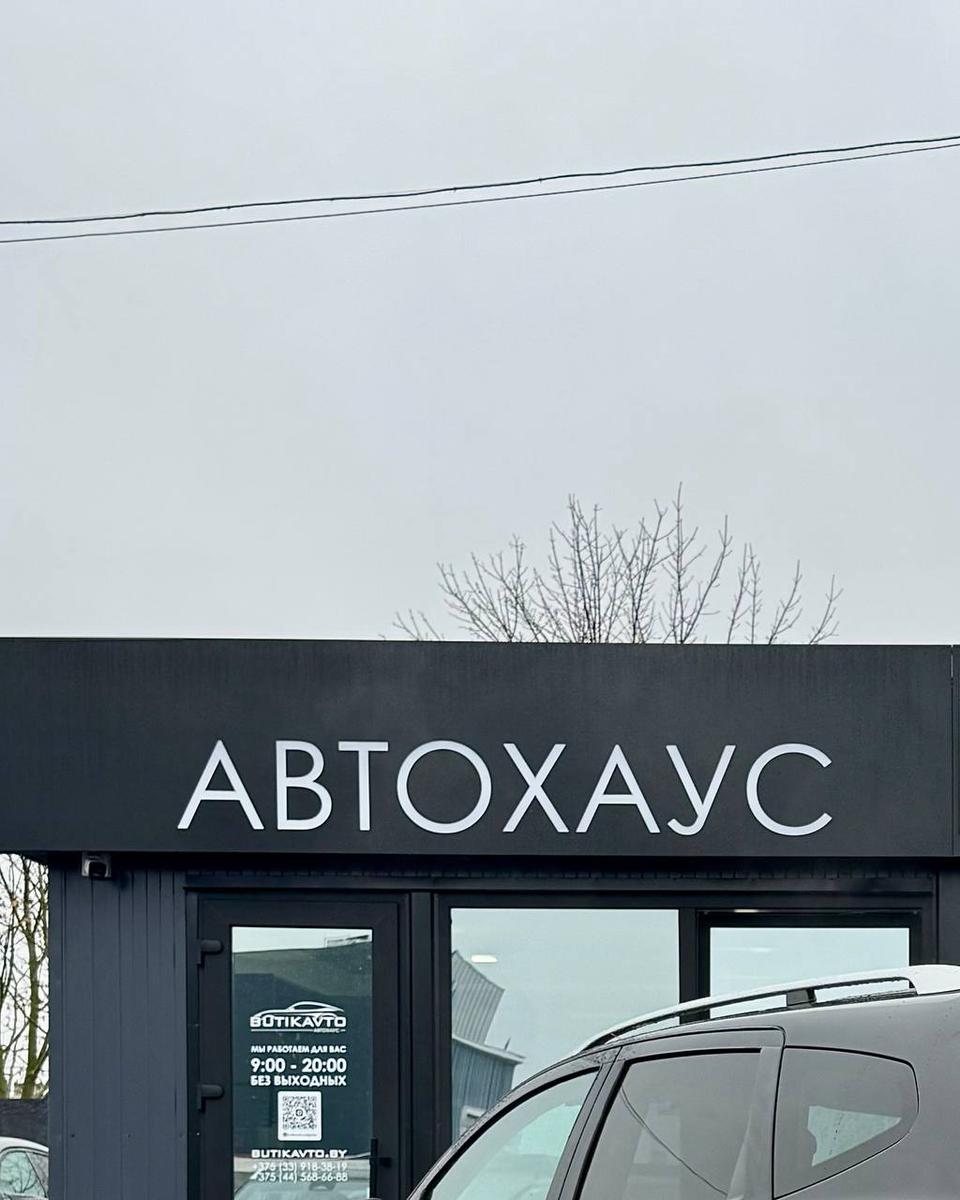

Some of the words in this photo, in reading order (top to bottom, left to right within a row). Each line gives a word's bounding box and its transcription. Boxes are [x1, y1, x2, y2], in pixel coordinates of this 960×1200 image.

[177, 739, 833, 837] АВТОХАУС
[250, 1016, 347, 1028] BUTIKAVTO
[251, 1045, 266, 1053] МЫ
[267, 1045, 310, 1053] РАБОТАЕМ
[310, 1045, 328, 1054] ДЛЯ
[329, 1045, 347, 1053] ВАС
[250, 1057, 286, 1073] 9:00
[302, 1057, 347, 1073] 20:00
[250, 1075, 271, 1086] БЕЗ
[273, 1075, 347, 1087] ВЫХОДНЫХ
[251, 1149, 348, 1158] BUTIKAVTO.BY
[279, 1172, 297, 1183] (44)
[300, 1172, 348, 1182] 568-66-88
